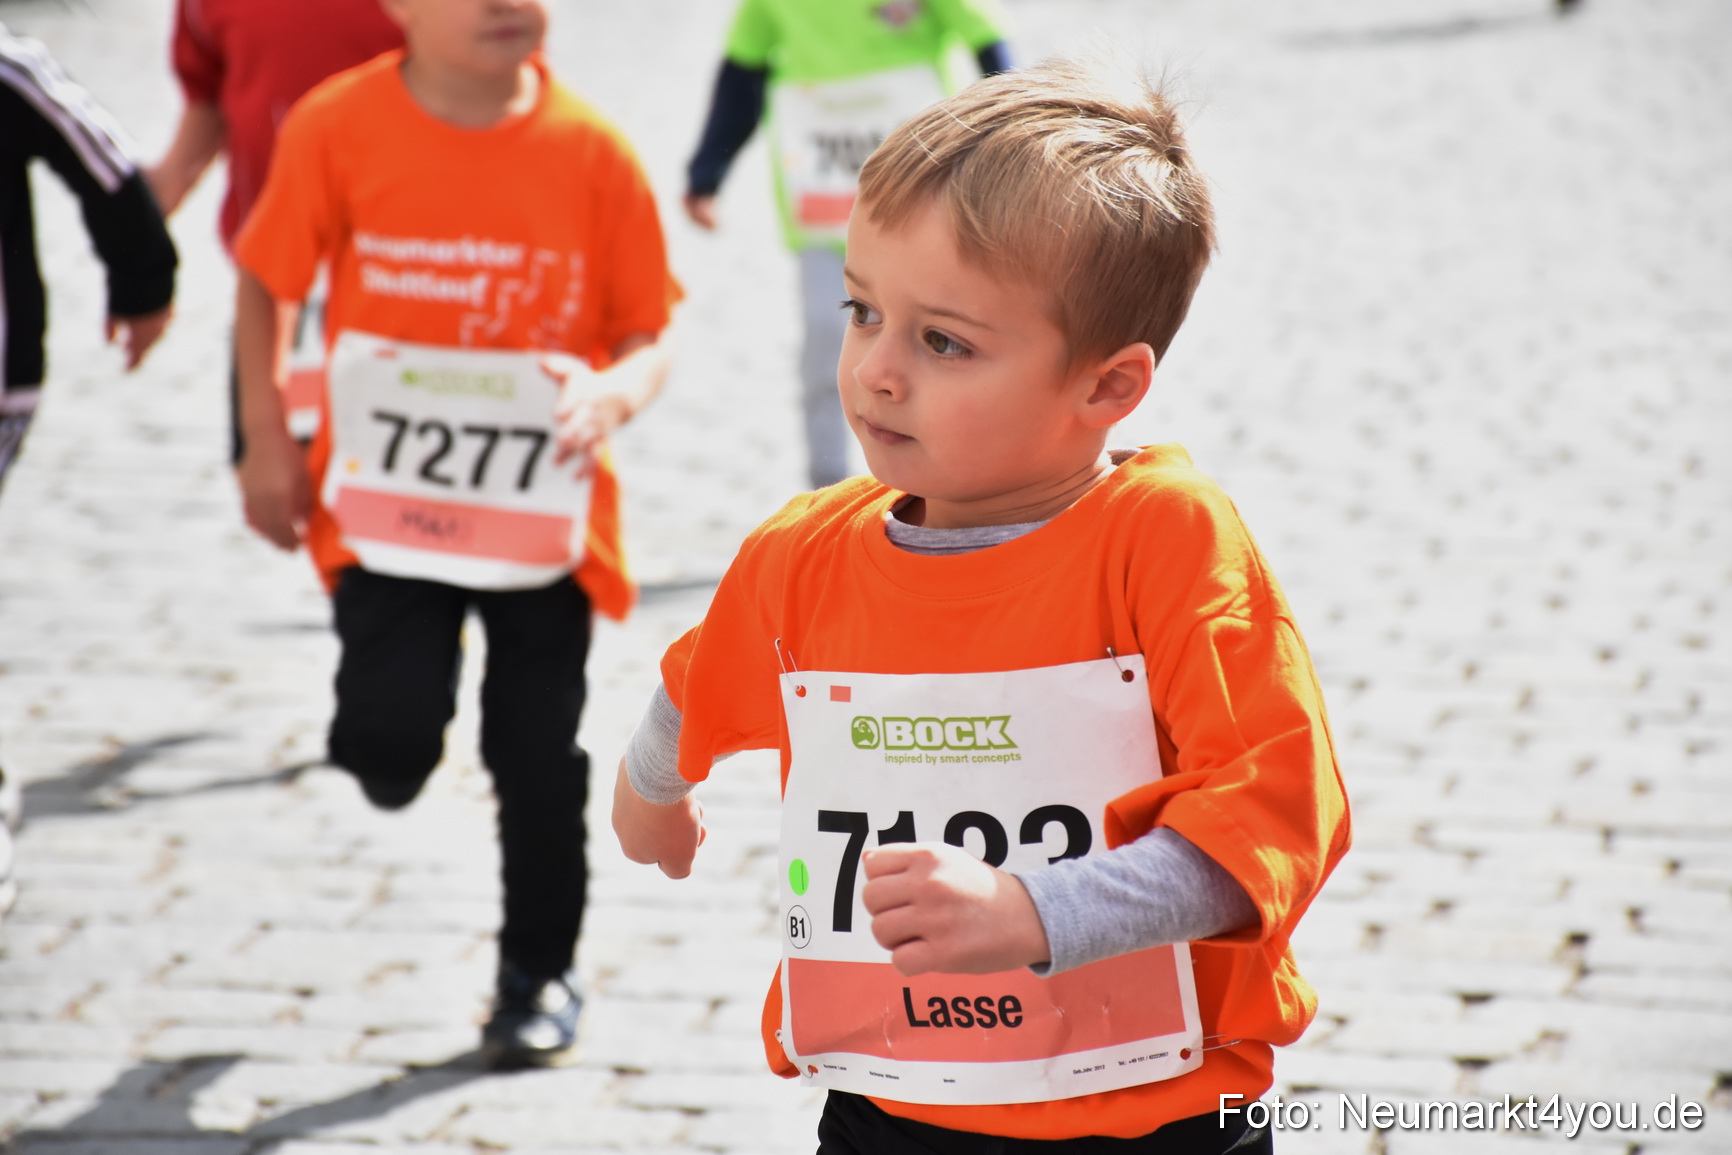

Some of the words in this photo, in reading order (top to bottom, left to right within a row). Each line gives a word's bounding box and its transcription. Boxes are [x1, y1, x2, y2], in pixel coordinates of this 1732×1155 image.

[371, 409, 549, 493] 7277
[883, 716, 1018, 750] BOCK
[885, 753, 923, 765] inspired
[925, 753, 937, 766] by
[940, 753, 969, 764] smart
[971, 752, 1022, 765] concepts
[790, 916, 806, 939] B1
[902, 987, 1023, 1029] Lasse
